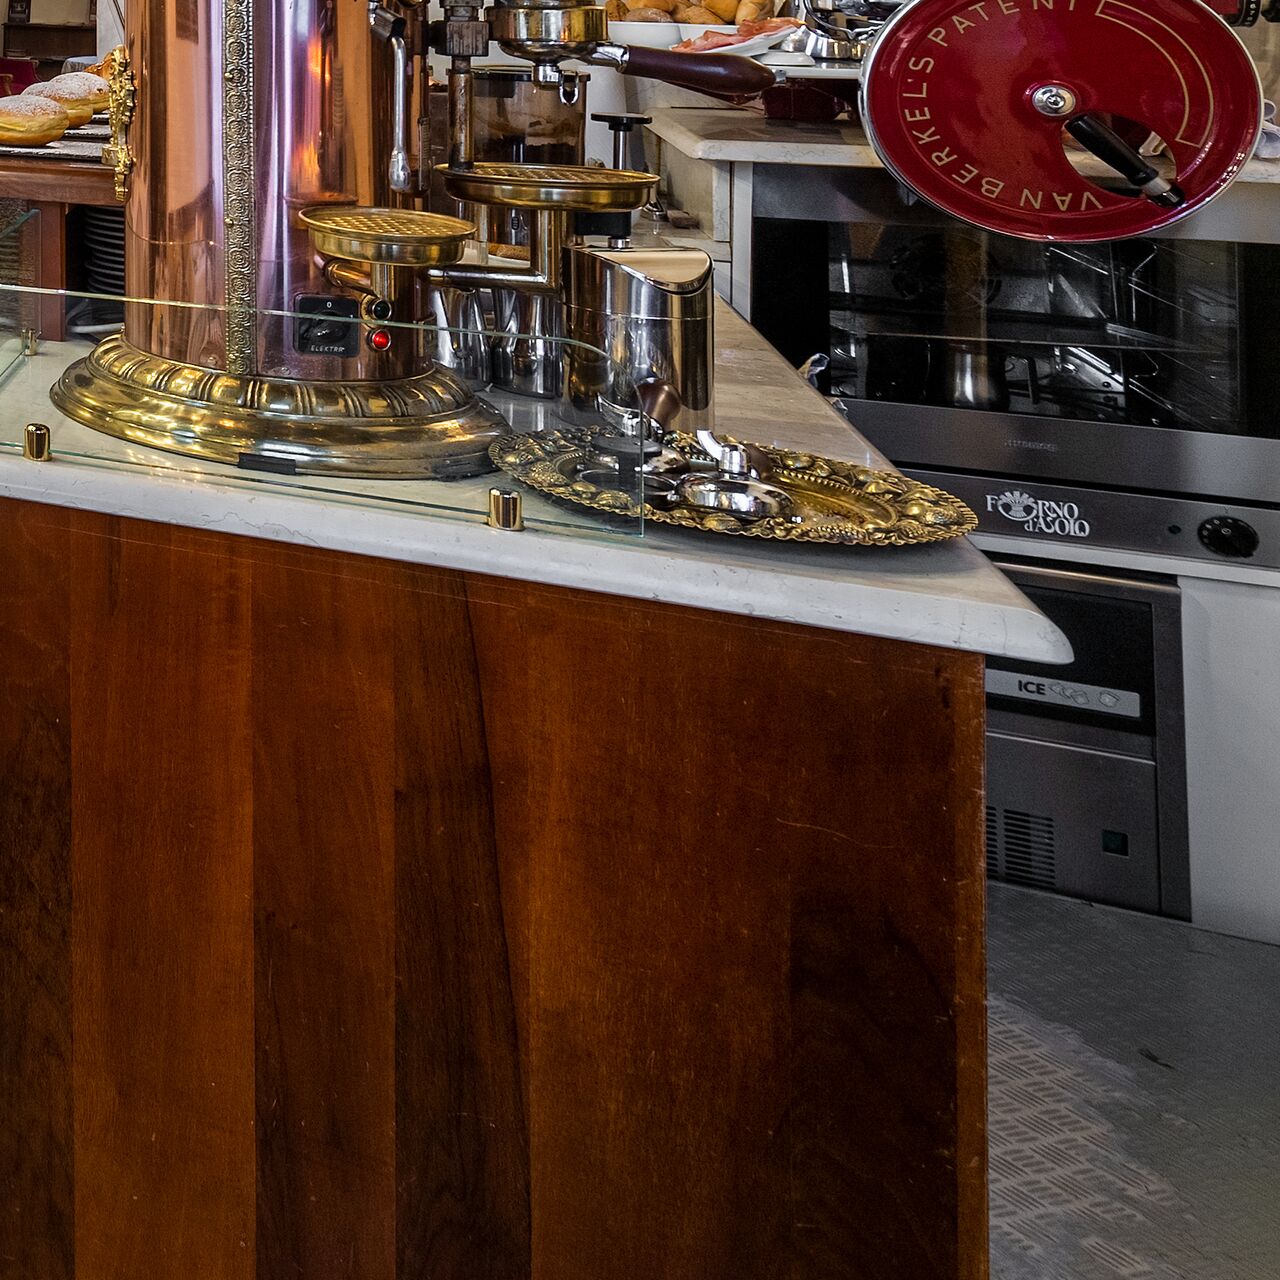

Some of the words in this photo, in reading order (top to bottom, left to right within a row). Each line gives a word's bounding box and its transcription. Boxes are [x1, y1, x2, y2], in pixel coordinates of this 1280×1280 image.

[902, 56, 1007, 198] BERKEL'S
[1019, 187, 1105, 213] VAN
[1017, 679, 1047, 696] ICE
